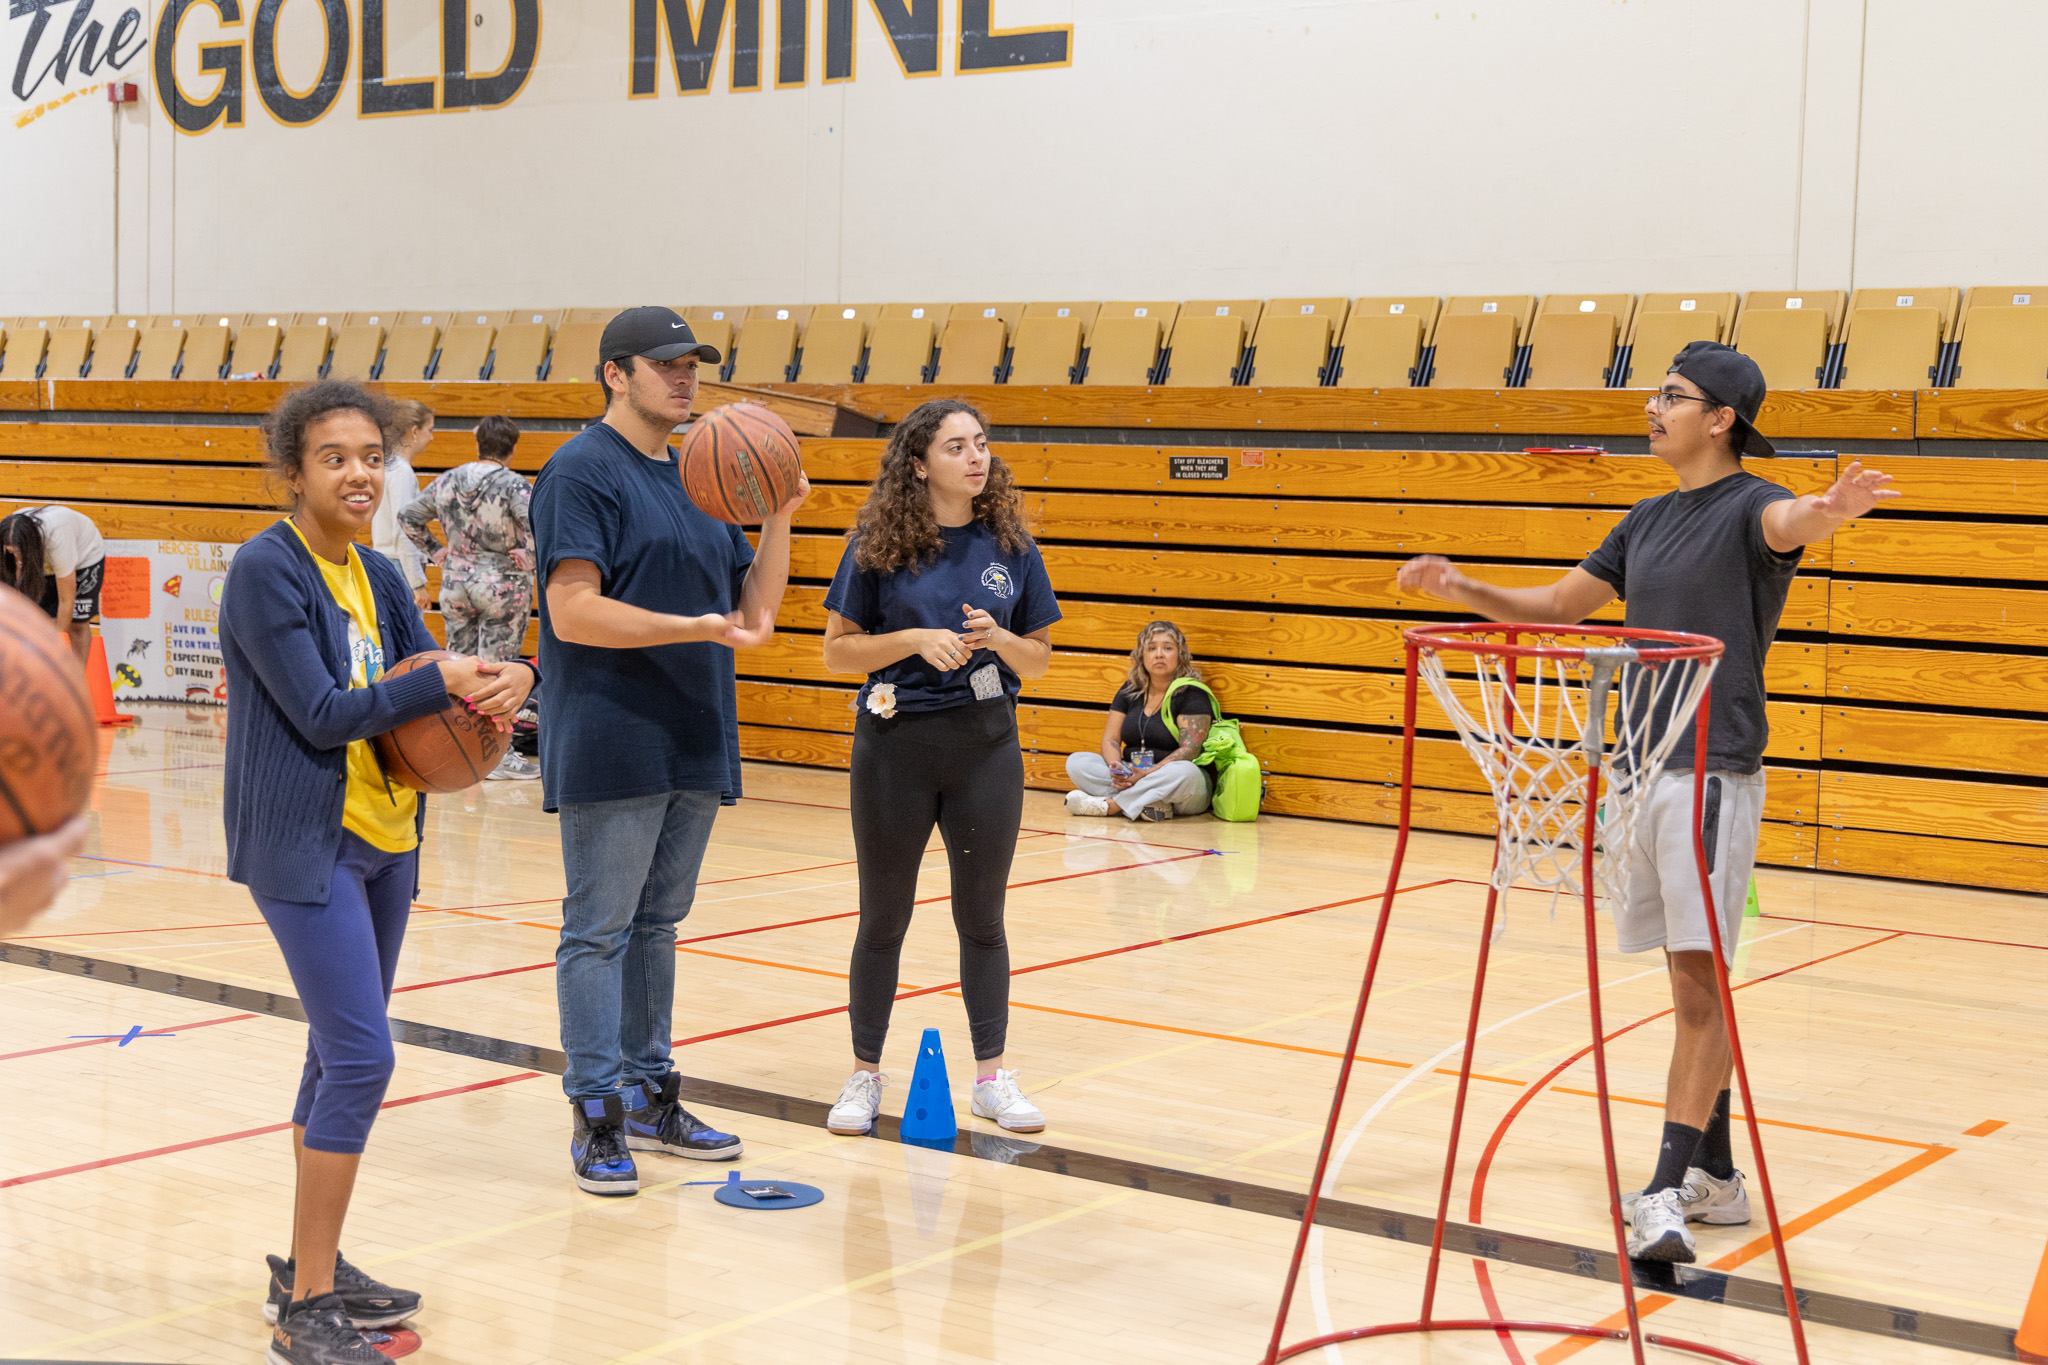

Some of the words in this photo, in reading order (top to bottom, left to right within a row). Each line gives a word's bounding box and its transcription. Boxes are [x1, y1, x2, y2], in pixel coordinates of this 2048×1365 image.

[154, 0, 543, 137] GOLD
[158, 541, 200, 557] HEROES
[210, 543, 224, 558] VS
[184, 608, 218, 623] RULES
[191, 626, 206, 635] FUN
[184, 640, 196, 648] ON
[197, 641, 211, 650] THE
[190, 668, 214, 679] RULES
